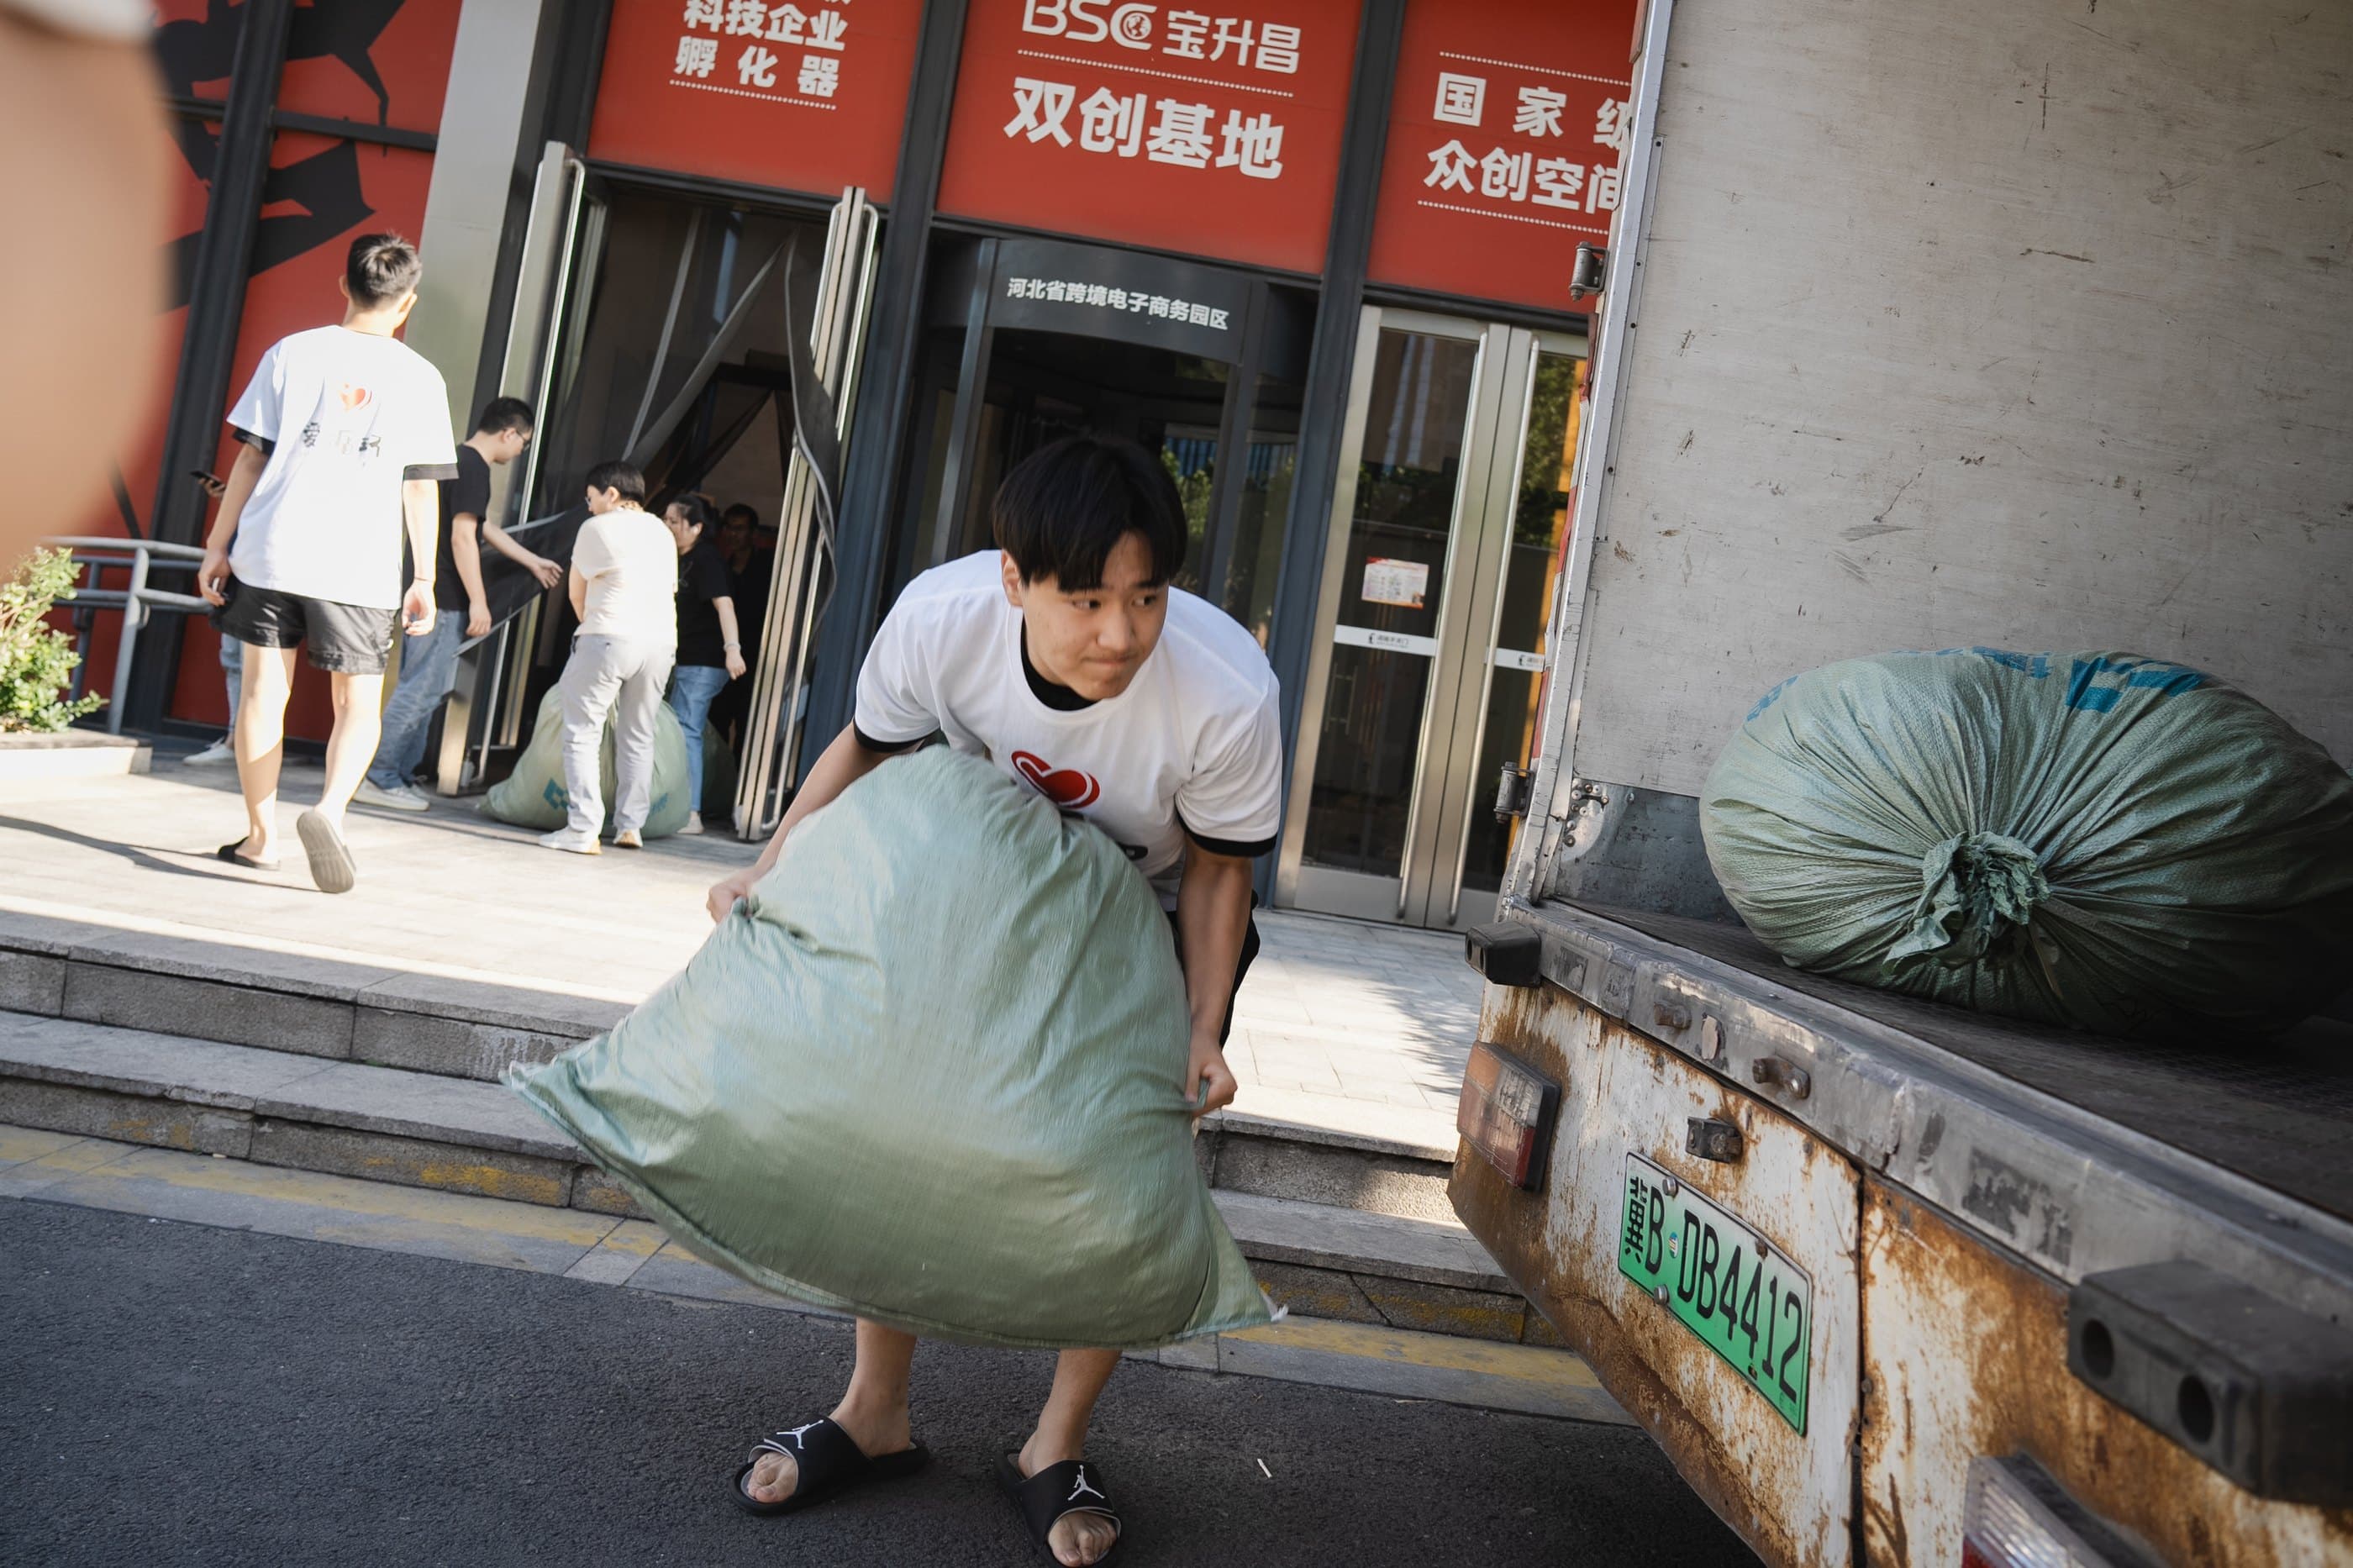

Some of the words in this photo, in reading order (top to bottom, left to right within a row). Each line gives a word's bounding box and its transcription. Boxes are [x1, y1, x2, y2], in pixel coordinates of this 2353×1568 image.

[683, 0, 848, 50] 科技企业
[1162, 10, 1301, 74] 宝升昌
[674, 36, 840, 97] 孵化器
[1003, 76, 1285, 180] 双创基地
[1007, 277, 1229, 330] 河北省跨境电子商务园区
